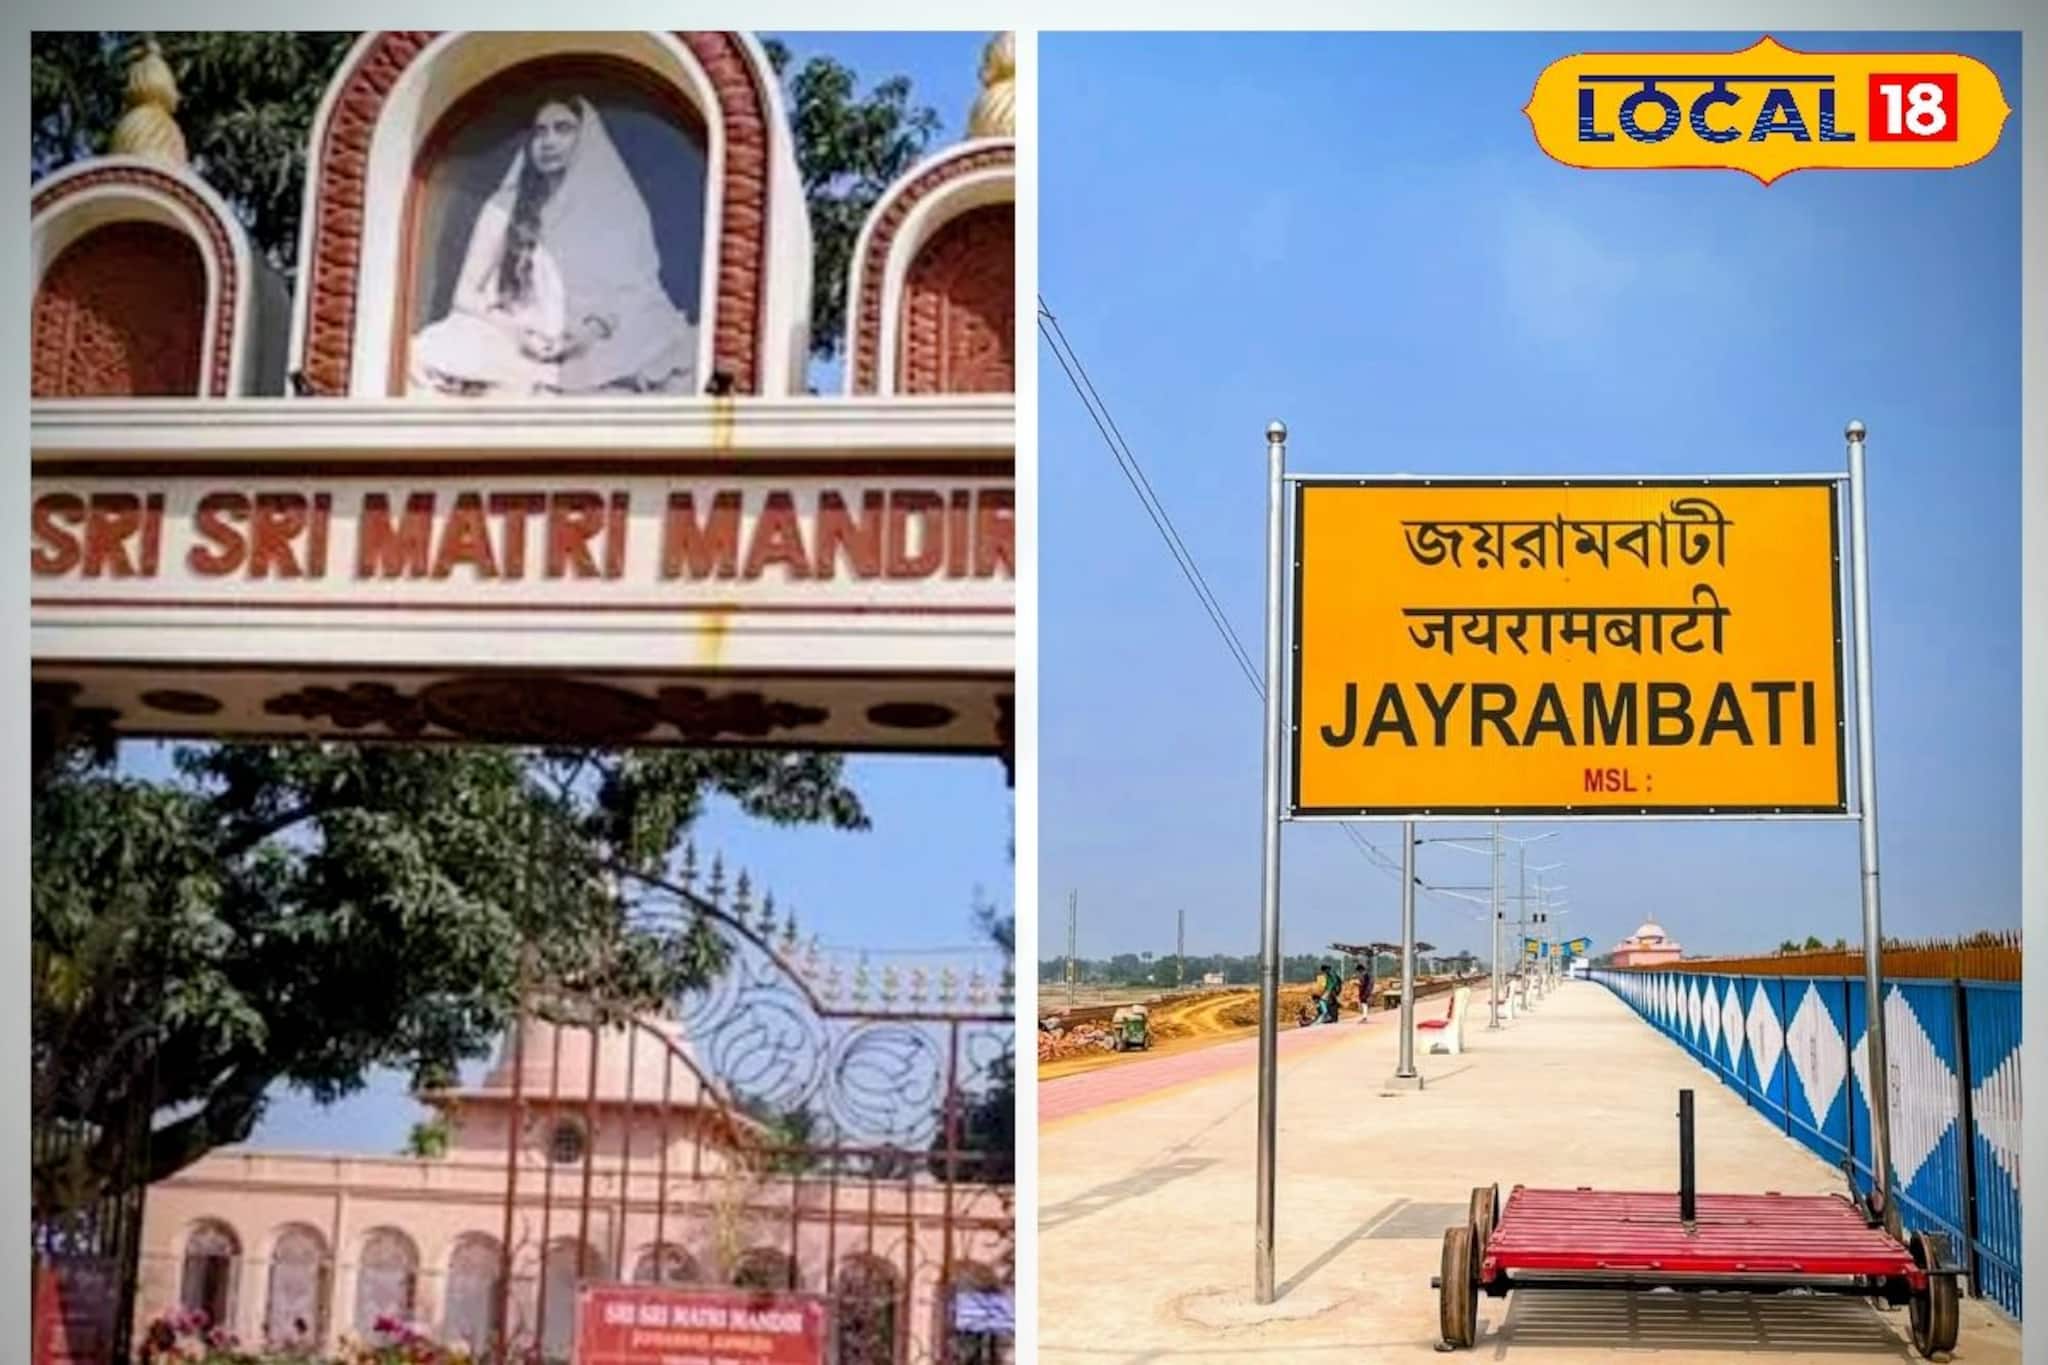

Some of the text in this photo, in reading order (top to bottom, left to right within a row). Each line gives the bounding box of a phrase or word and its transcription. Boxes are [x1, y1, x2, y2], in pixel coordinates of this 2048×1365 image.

[31, 488, 1015, 581] SRI SRI MATRI MANDIR
[1401, 498, 1733, 568] জয়রামবাটী
[1403, 584, 1731, 654] जयरामबाटी
[1321, 682, 1816, 746] JAYRAMBATI
[1584, 769, 1637, 792] MSL
